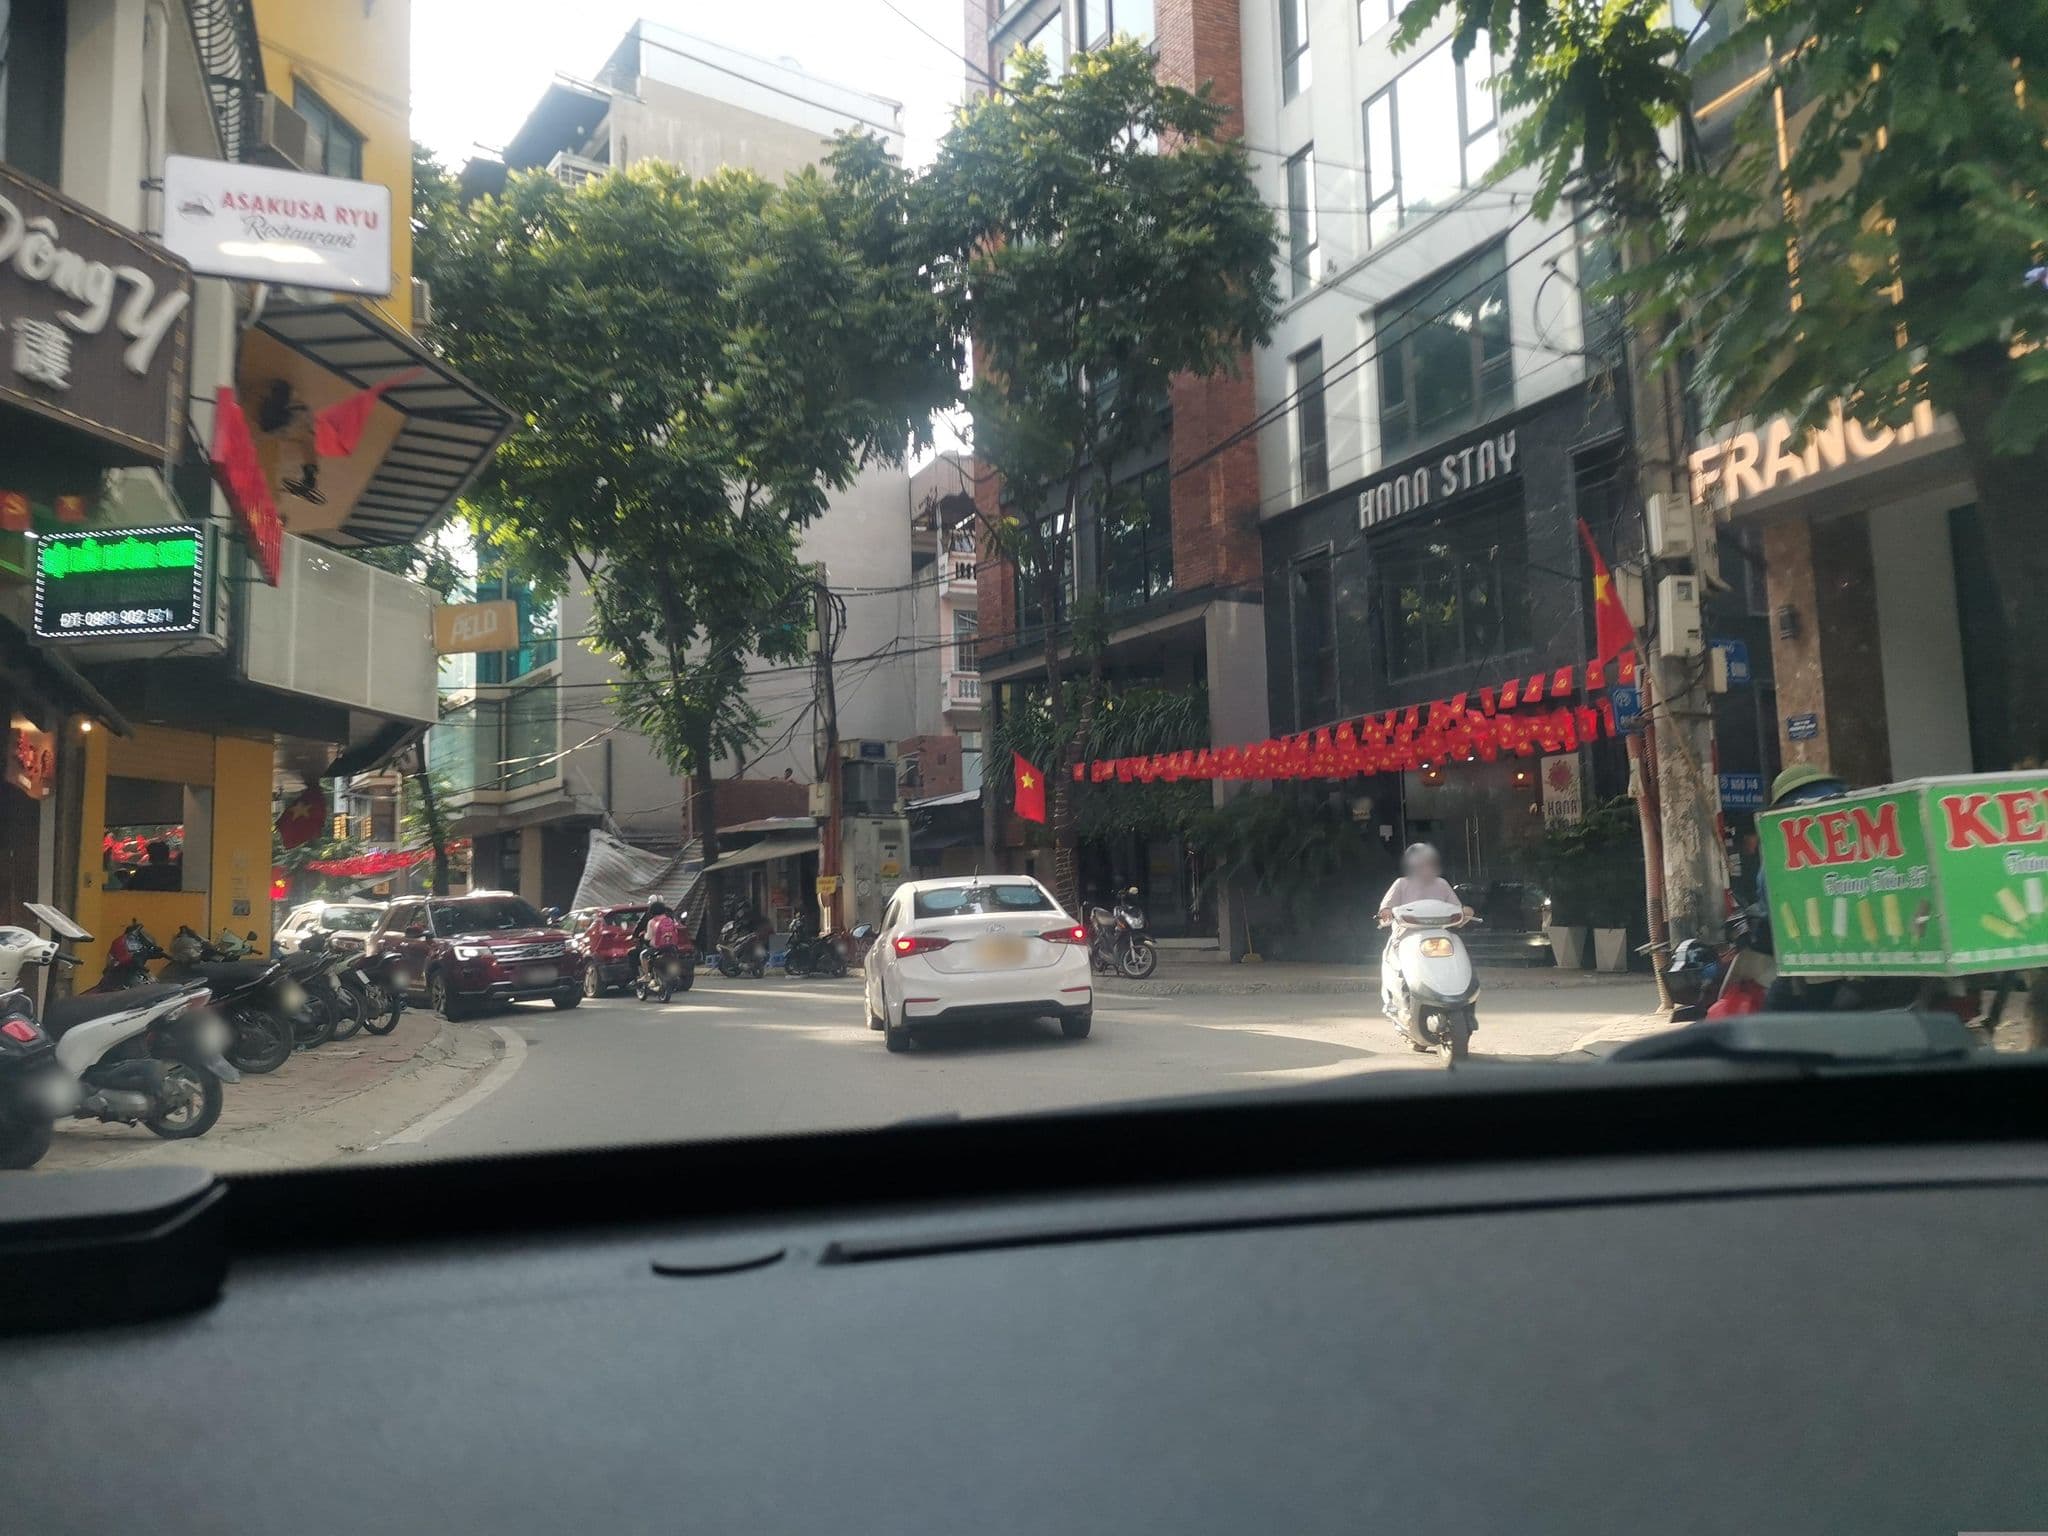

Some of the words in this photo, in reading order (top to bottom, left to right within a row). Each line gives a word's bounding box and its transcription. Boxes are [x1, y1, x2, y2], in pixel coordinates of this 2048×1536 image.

[221, 191, 327, 223] ASAKUSA
[335, 202, 379, 230] RYU
[1440, 429, 1516, 497] STAY
[1779, 802, 1905, 871] KEM
[1938, 788, 2048, 851] KE
